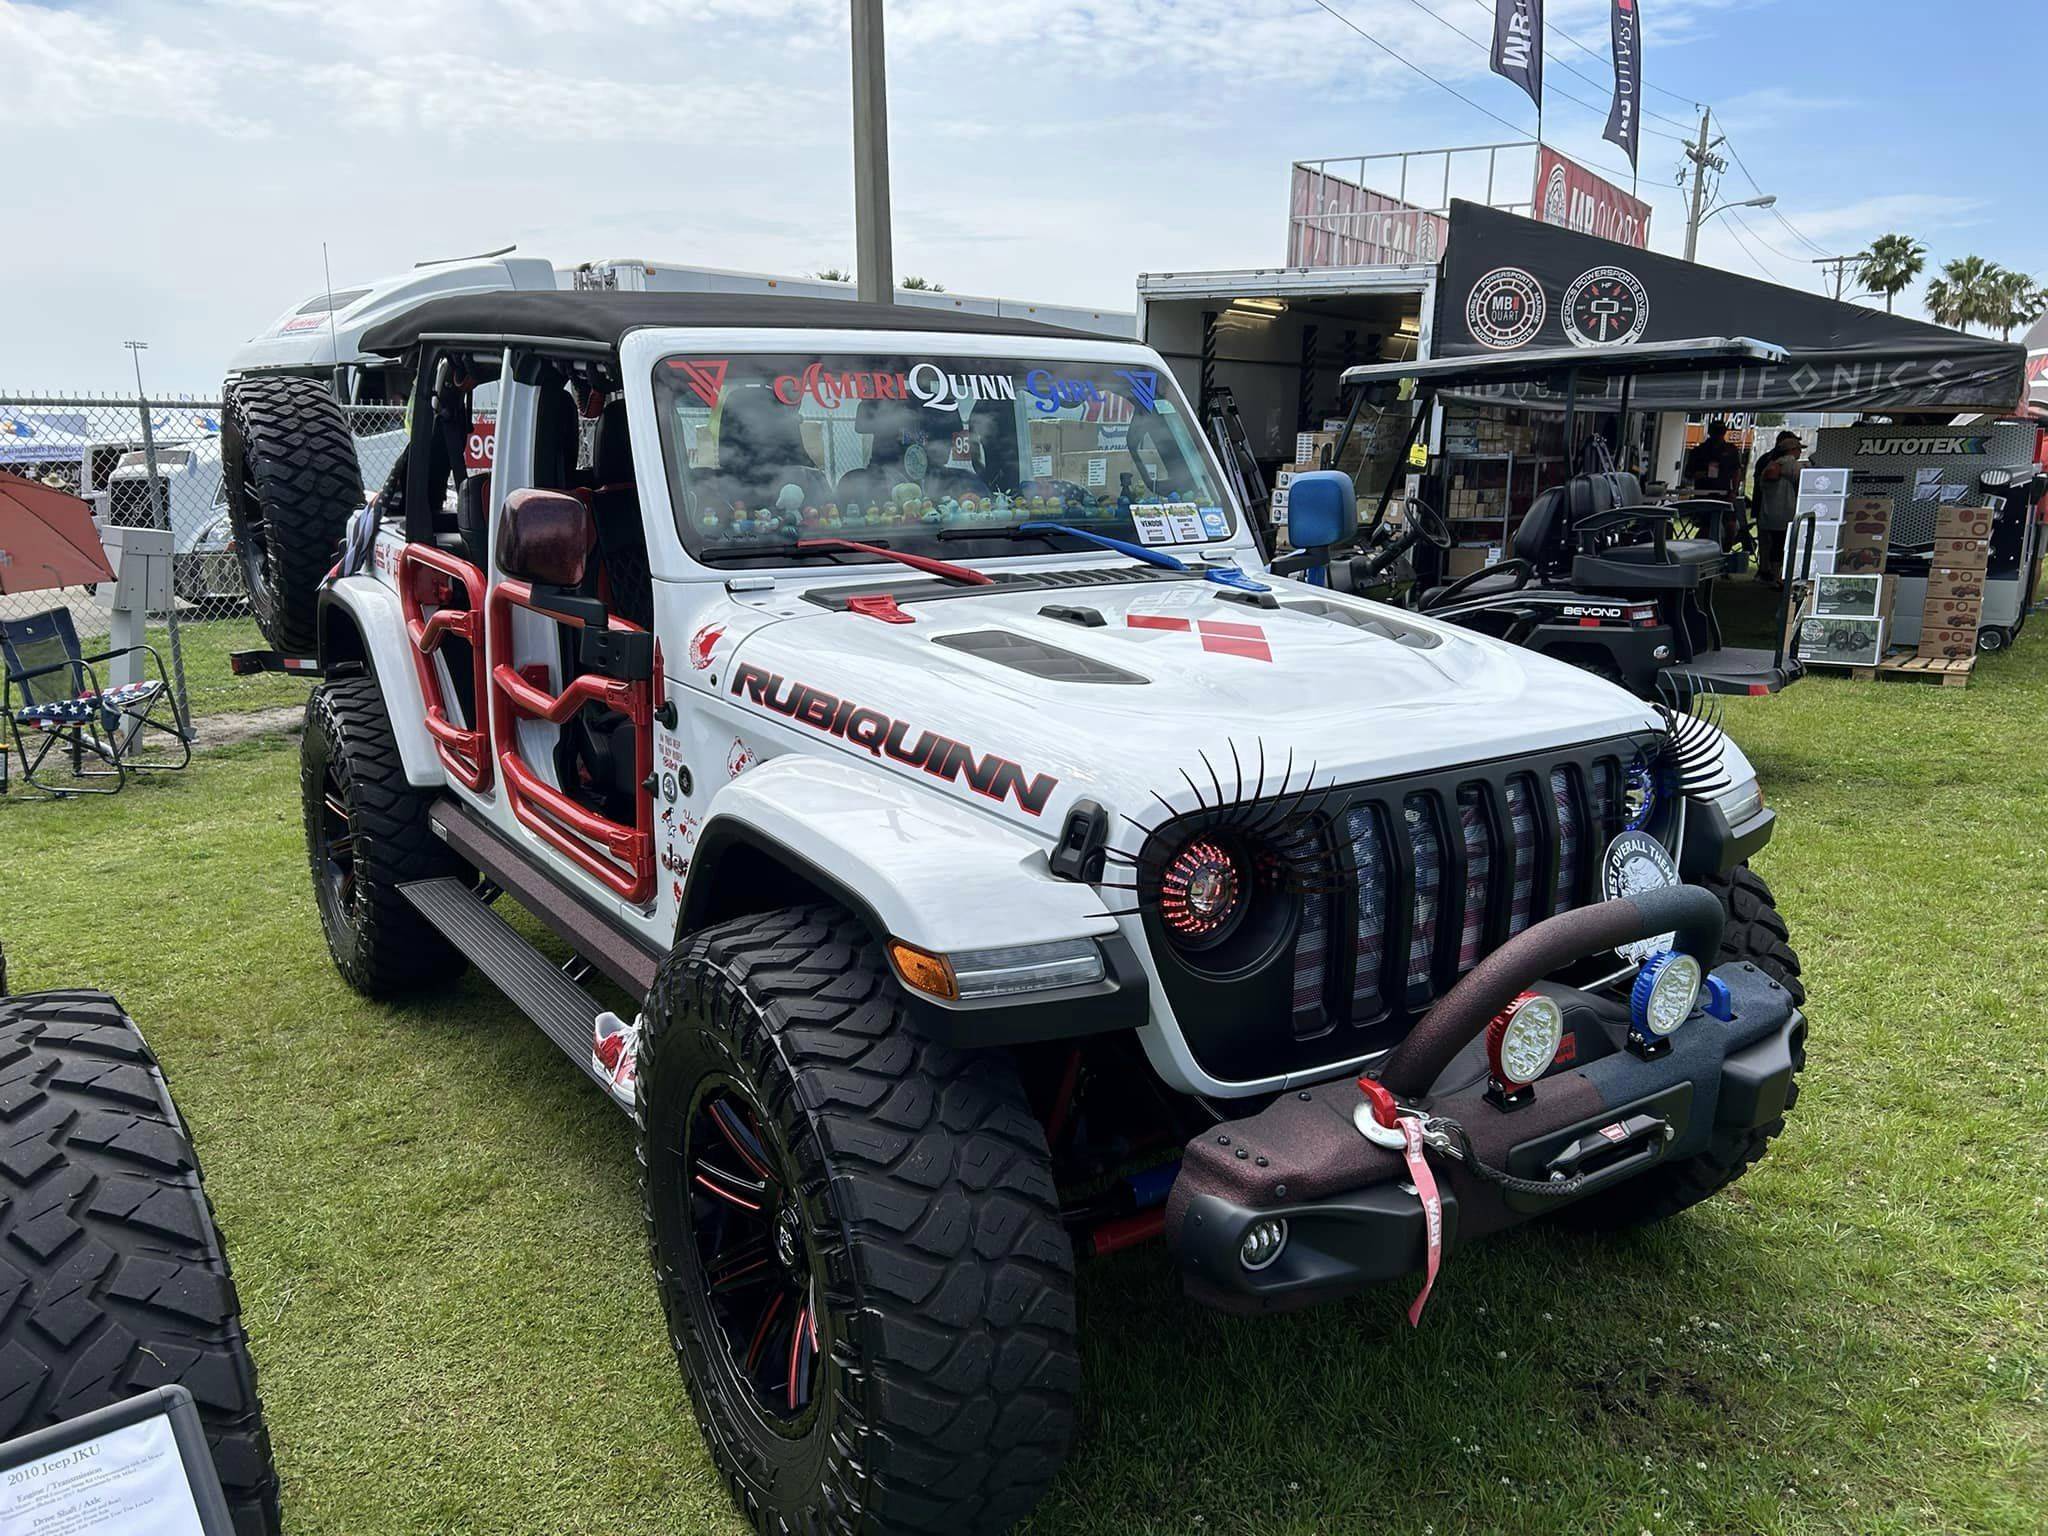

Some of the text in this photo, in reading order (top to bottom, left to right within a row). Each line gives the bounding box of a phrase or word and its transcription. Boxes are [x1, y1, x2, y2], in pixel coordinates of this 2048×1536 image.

[1480, 271, 1535, 288] POWERSPORTS
[1469, 292, 1480, 323] MOBILE
[1534, 292, 1542, 324] MARINE
[1575, 269, 1640, 291] POWERSPORTS
[1633, 291, 1646, 334] DIVISION
[1491, 310, 1519, 322] QUART
[1473, 325, 1534, 346] AUDIO PRODUCTS
[1026, 370, 1108, 413] GIRL
[470, 434, 495, 460] 96
[955, 436, 971, 454] 95
[1857, 437, 1964, 455] AUTOTEK
[1141, 519, 1163, 528] VENDOR
[1563, 606, 1621, 617] BEYOND
[731, 662, 1059, 817] RUBIQUINN
[1611, 839, 1648, 868] OVERALL
[1649, 845, 1678, 886] THEME
[1426, 1197, 1441, 1248] WARN
[7, 1465, 40, 1487] 2010
[41, 1457, 71, 1476] Jeep
[72, 1443, 101, 1465] JKU
[50, 1467, 103, 1490] Transmission
